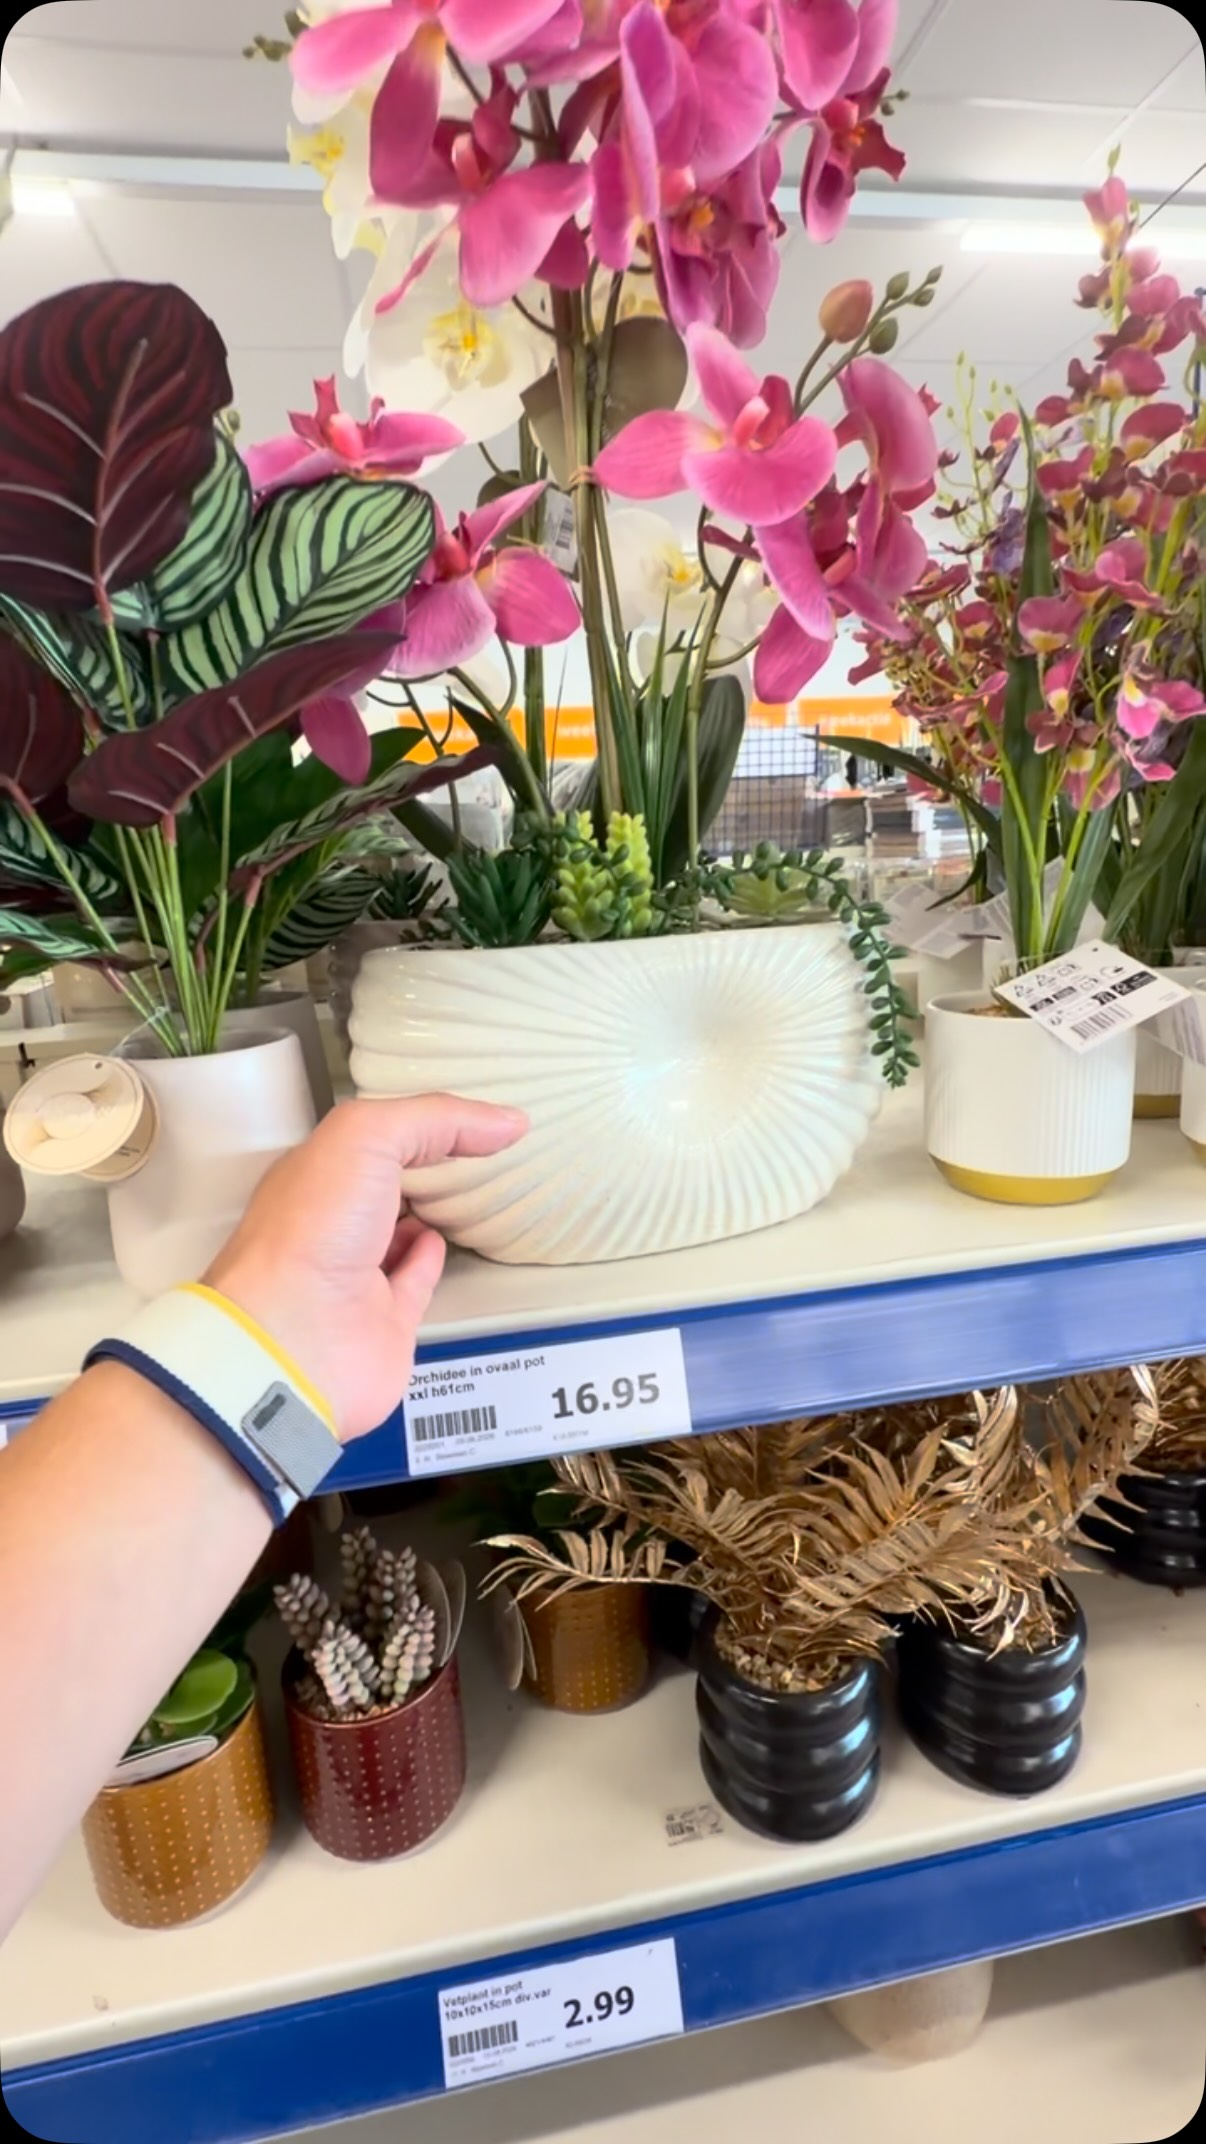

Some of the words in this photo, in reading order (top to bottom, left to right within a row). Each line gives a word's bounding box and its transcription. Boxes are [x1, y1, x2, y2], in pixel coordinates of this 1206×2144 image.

[408, 1368, 467, 1386] Orchidee
[470, 1365, 483, 1377] in
[485, 1359, 521, 1375] ovaal
[524, 1355, 546, 1371] pot
[408, 1387, 429, 1402] xxl
[431, 1382, 475, 1398] h61cm
[552, 1372, 660, 1419] 16.95
[443, 1989, 489, 2008] Vetplant
[491, 1986, 502, 1997] in
[504, 1980, 523, 1995] pot
[563, 1985, 635, 2029] 2.99
[445, 1997, 512, 2021] 10x10x15cm
